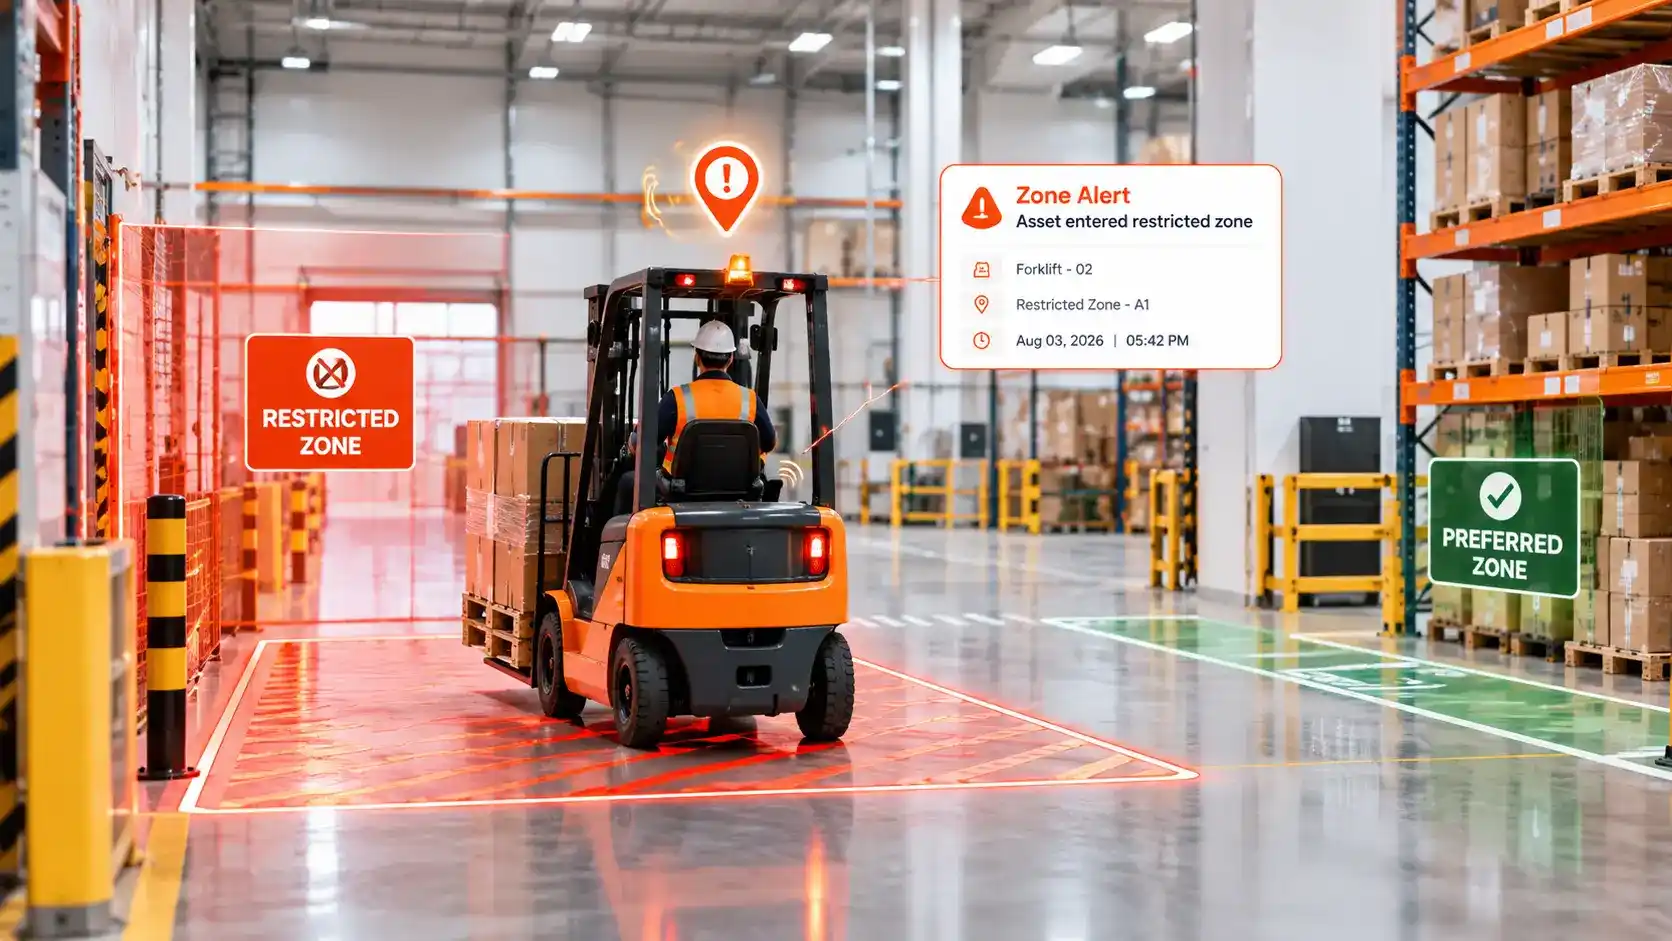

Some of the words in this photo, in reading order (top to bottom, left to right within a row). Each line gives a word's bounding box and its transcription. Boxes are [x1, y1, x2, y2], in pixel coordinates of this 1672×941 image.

[262, 408, 400, 428] RESTRICTED
[299, 436, 361, 455] ZONE
[1442, 527, 1563, 555] PREFERRED
[1472, 556, 1528, 580] ZONE
